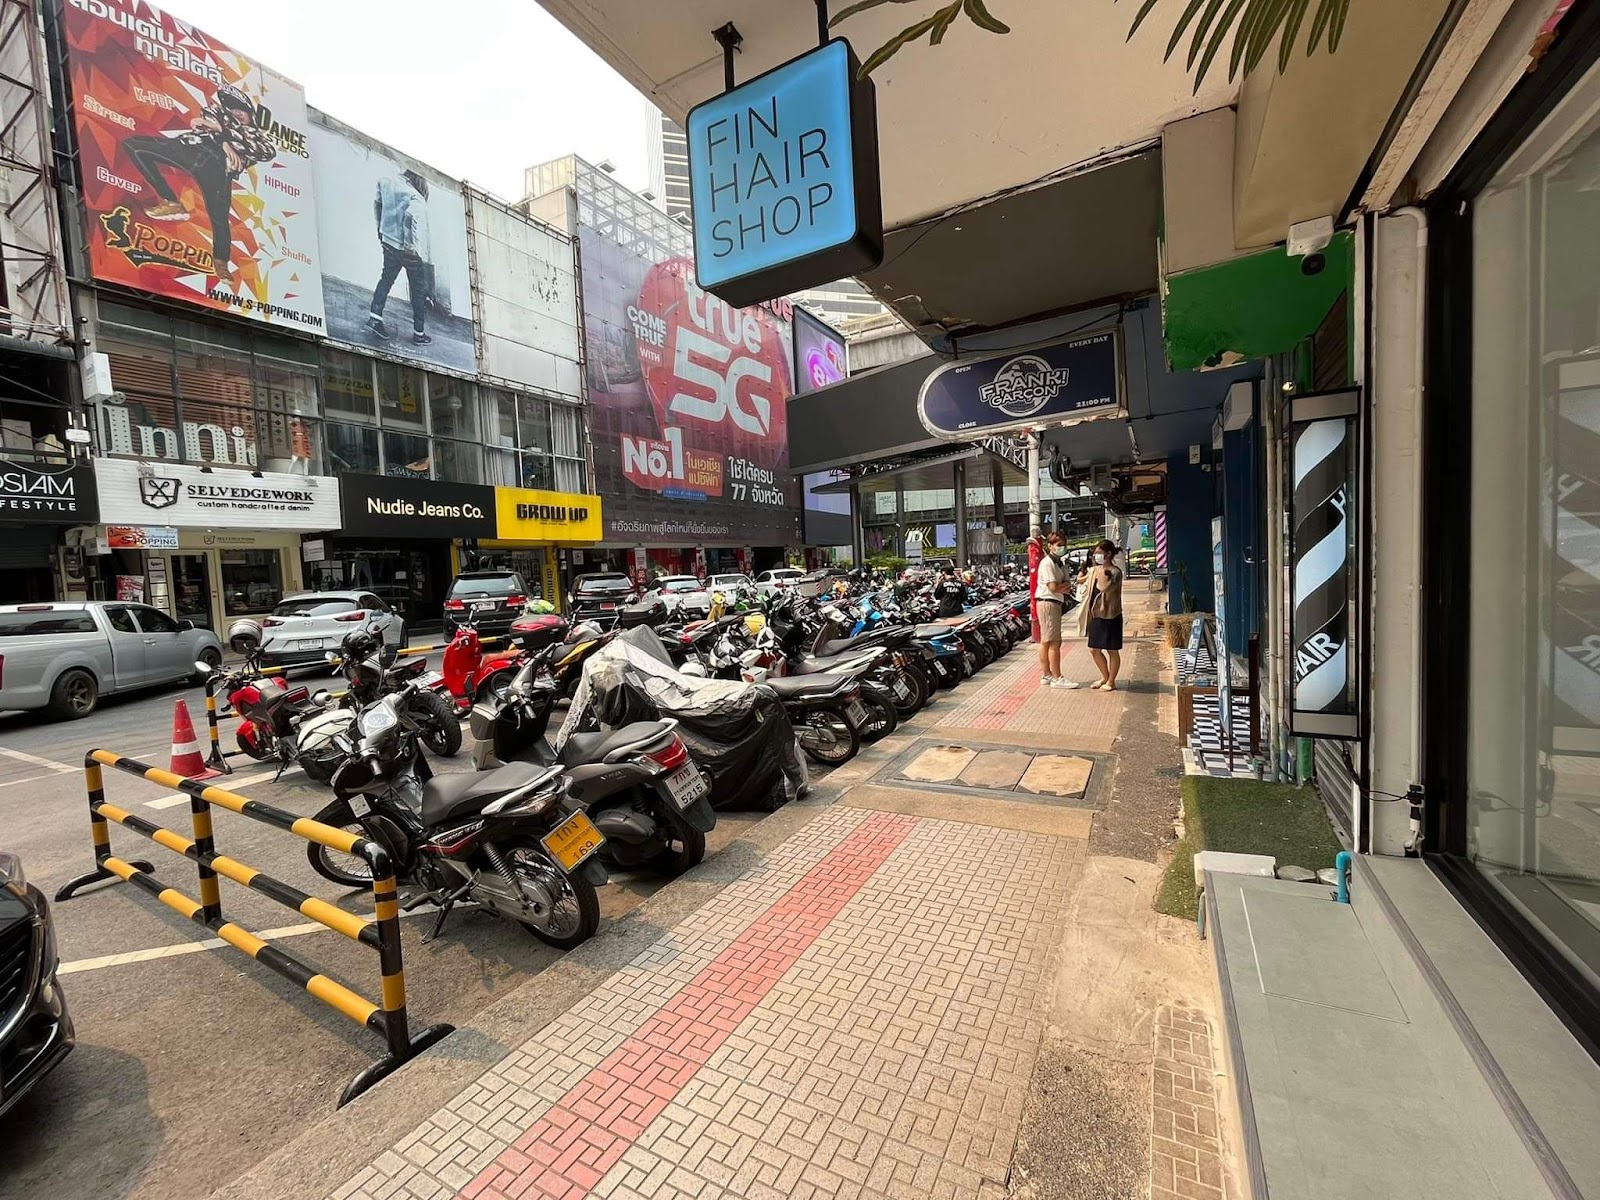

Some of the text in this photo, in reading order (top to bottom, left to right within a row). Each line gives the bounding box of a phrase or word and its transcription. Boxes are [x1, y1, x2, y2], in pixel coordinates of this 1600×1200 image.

[83, 94, 136, 131] Street
[256, 103, 306, 149] DANCE
[706, 95, 778, 166] FIN
[265, 133, 309, 159] STUDIO
[96, 165, 142, 194] Cover
[709, 128, 830, 212] HAIR
[264, 174, 301, 198] HIPHOP
[711, 182, 833, 258] SHOP
[281, 246, 312, 265] Shuffle
[207, 288, 323, 328] WWW.S-POPPING.COM
[626, 305, 667, 336] COME
[683, 280, 762, 354] true
[632, 322, 665, 349] TRUE
[1069, 335, 1108, 348] EVERY DAY
[639, 347, 661, 363] WITH
[669, 325, 772, 437] 5G
[955, 366, 972, 374] OPEN
[981, 368, 1068, 402] FRANK!
[991, 385, 1057, 405] GARÇON
[1100, 396, 1111, 404] PM
[958, 421, 977, 429] CLOSE
[622, 427, 685, 480] No.1
[728, 456, 774, 484] ใช้ได้ครบ
[187, 484, 314, 501] SELVEDGEWORK
[731, 483, 784, 506] 77 จังหวัด
[287, 504, 311, 512] denim
[367, 497, 485, 519] Nudie Jeans Co.
[516, 503, 588, 522] GROW UP
[681, 783, 703, 805] 5215
